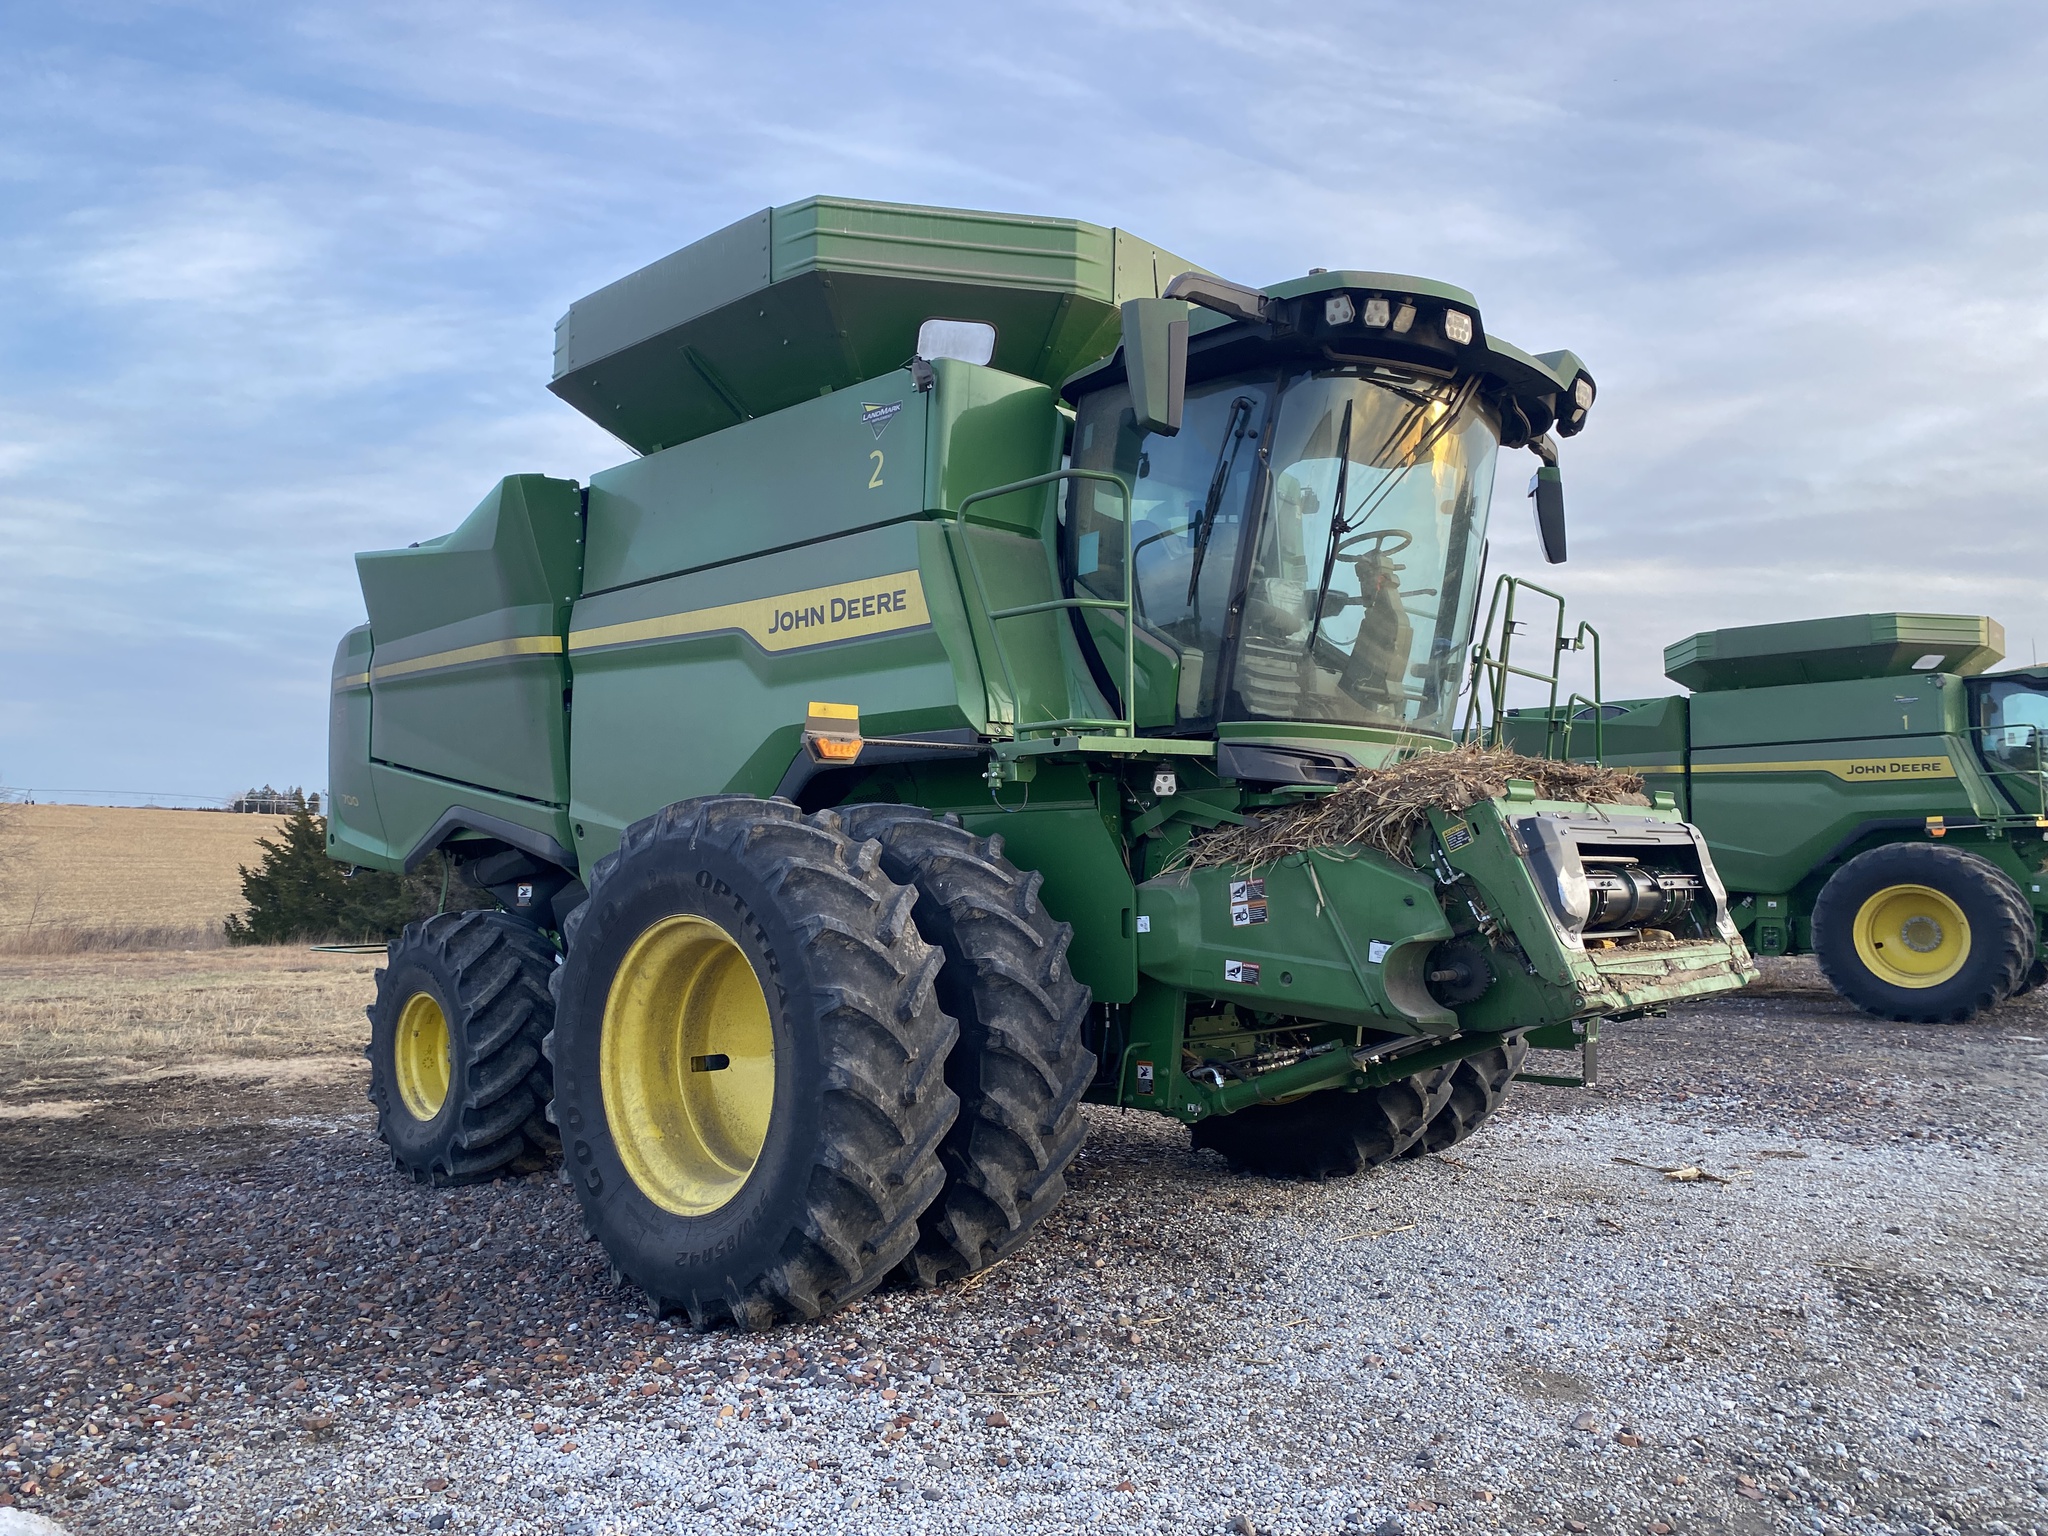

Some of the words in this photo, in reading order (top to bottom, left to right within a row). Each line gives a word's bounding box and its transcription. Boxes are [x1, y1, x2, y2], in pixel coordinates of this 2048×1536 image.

[868, 449, 884, 489] 2
[768, 605, 824, 634] JOHN
[831, 589, 907, 623] DEERE
[1902, 715, 1908, 730] 1
[1846, 764, 1886, 774] JOHN
[1890, 763, 1941, 773] DEERE
[695, 870, 794, 1038] OPTITRAC
